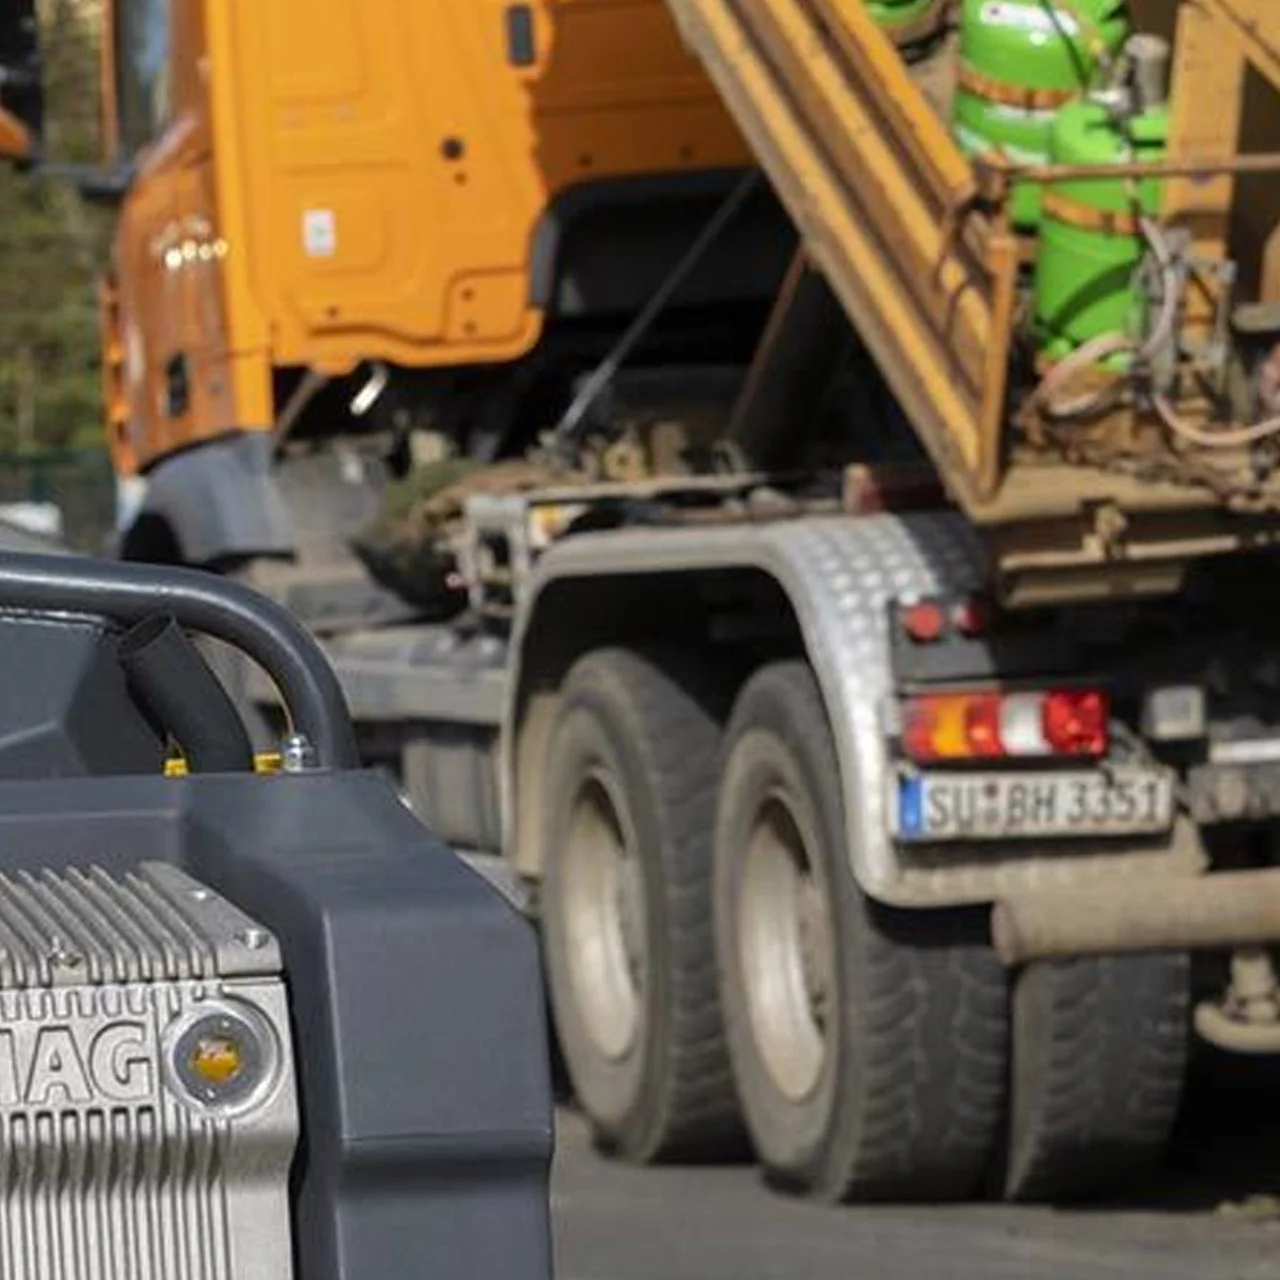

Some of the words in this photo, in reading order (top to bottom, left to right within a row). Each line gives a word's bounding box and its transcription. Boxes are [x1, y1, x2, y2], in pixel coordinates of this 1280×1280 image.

[927, 784, 976, 830] SU
[1006, 783, 1058, 827] BH
[1065, 780, 1159, 824] 3351
